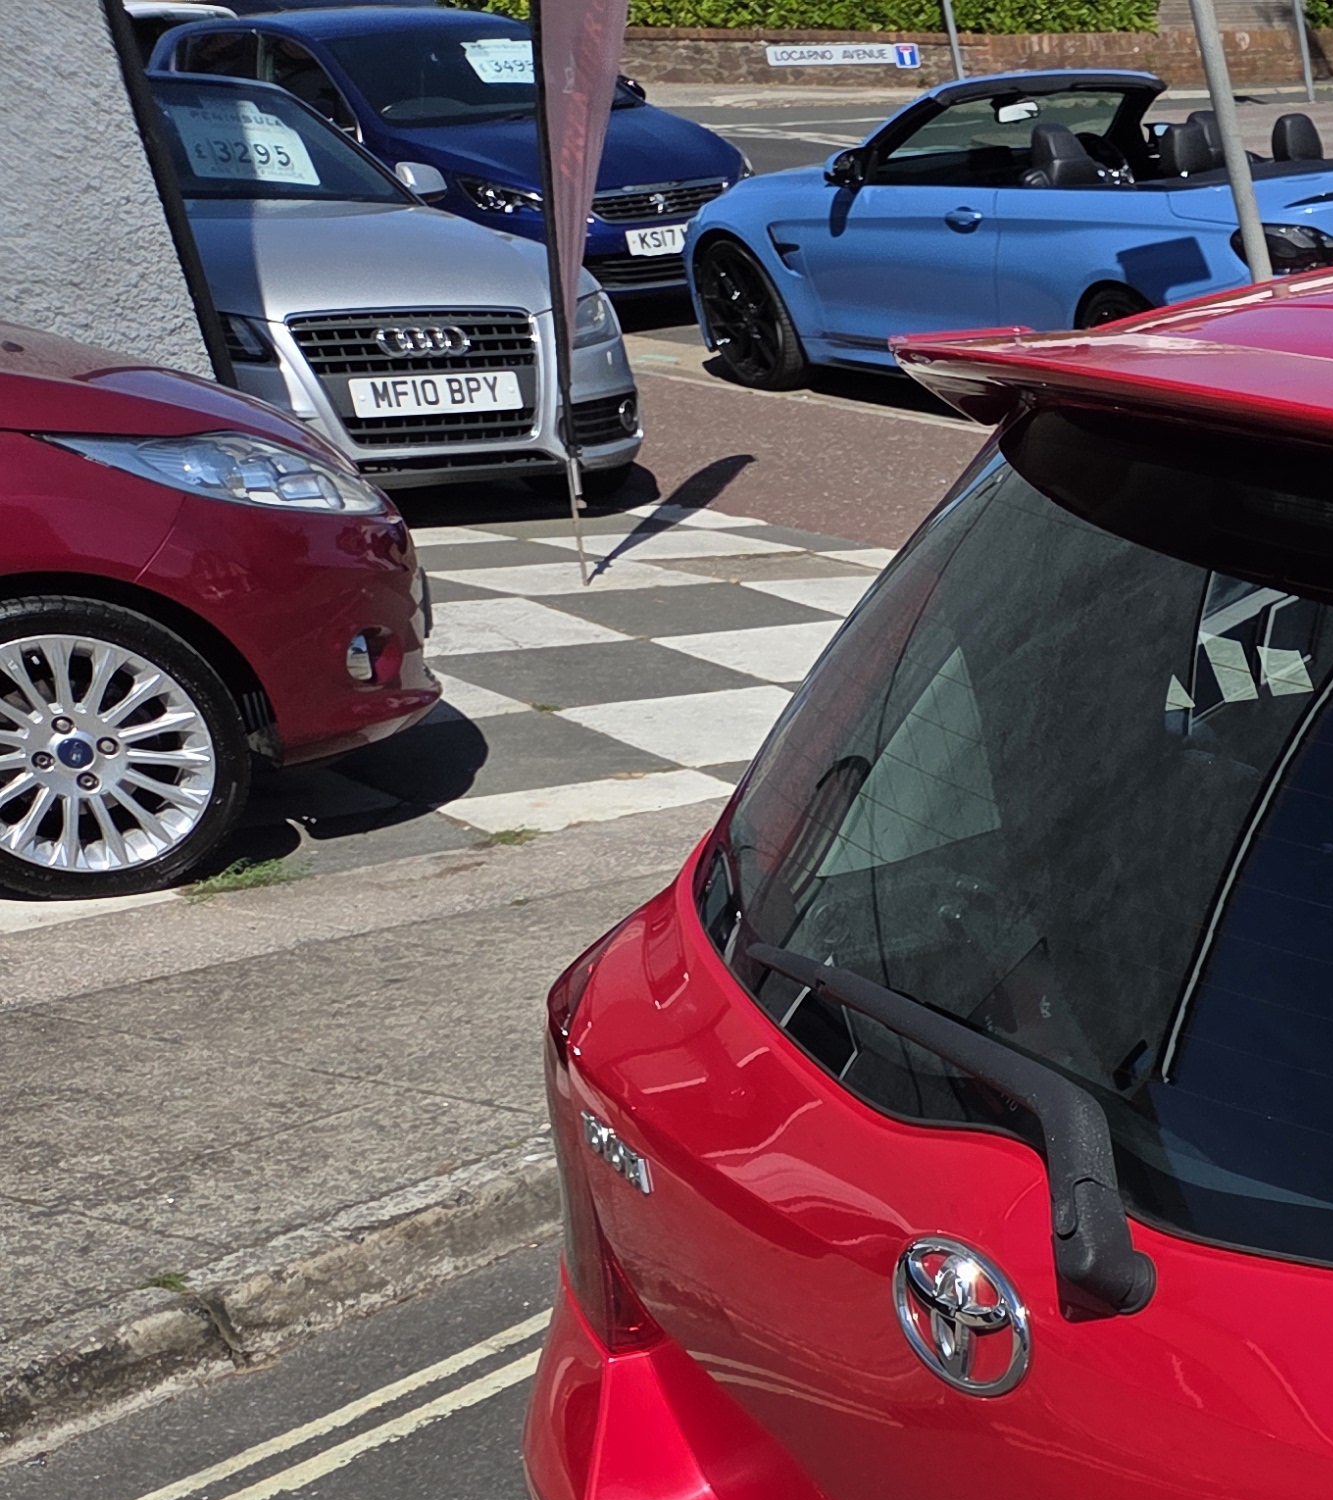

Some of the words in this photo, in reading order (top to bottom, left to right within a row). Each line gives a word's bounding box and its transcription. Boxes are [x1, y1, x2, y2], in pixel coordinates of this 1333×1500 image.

[774, 50, 834, 61] LOCARNO
[842, 49, 888, 60] AVENUE
[194, 140, 291, 167] £3295
[638, 229, 676, 250] KS17
[370, 379, 440, 408] MF10
[446, 376, 498, 405] BPY
